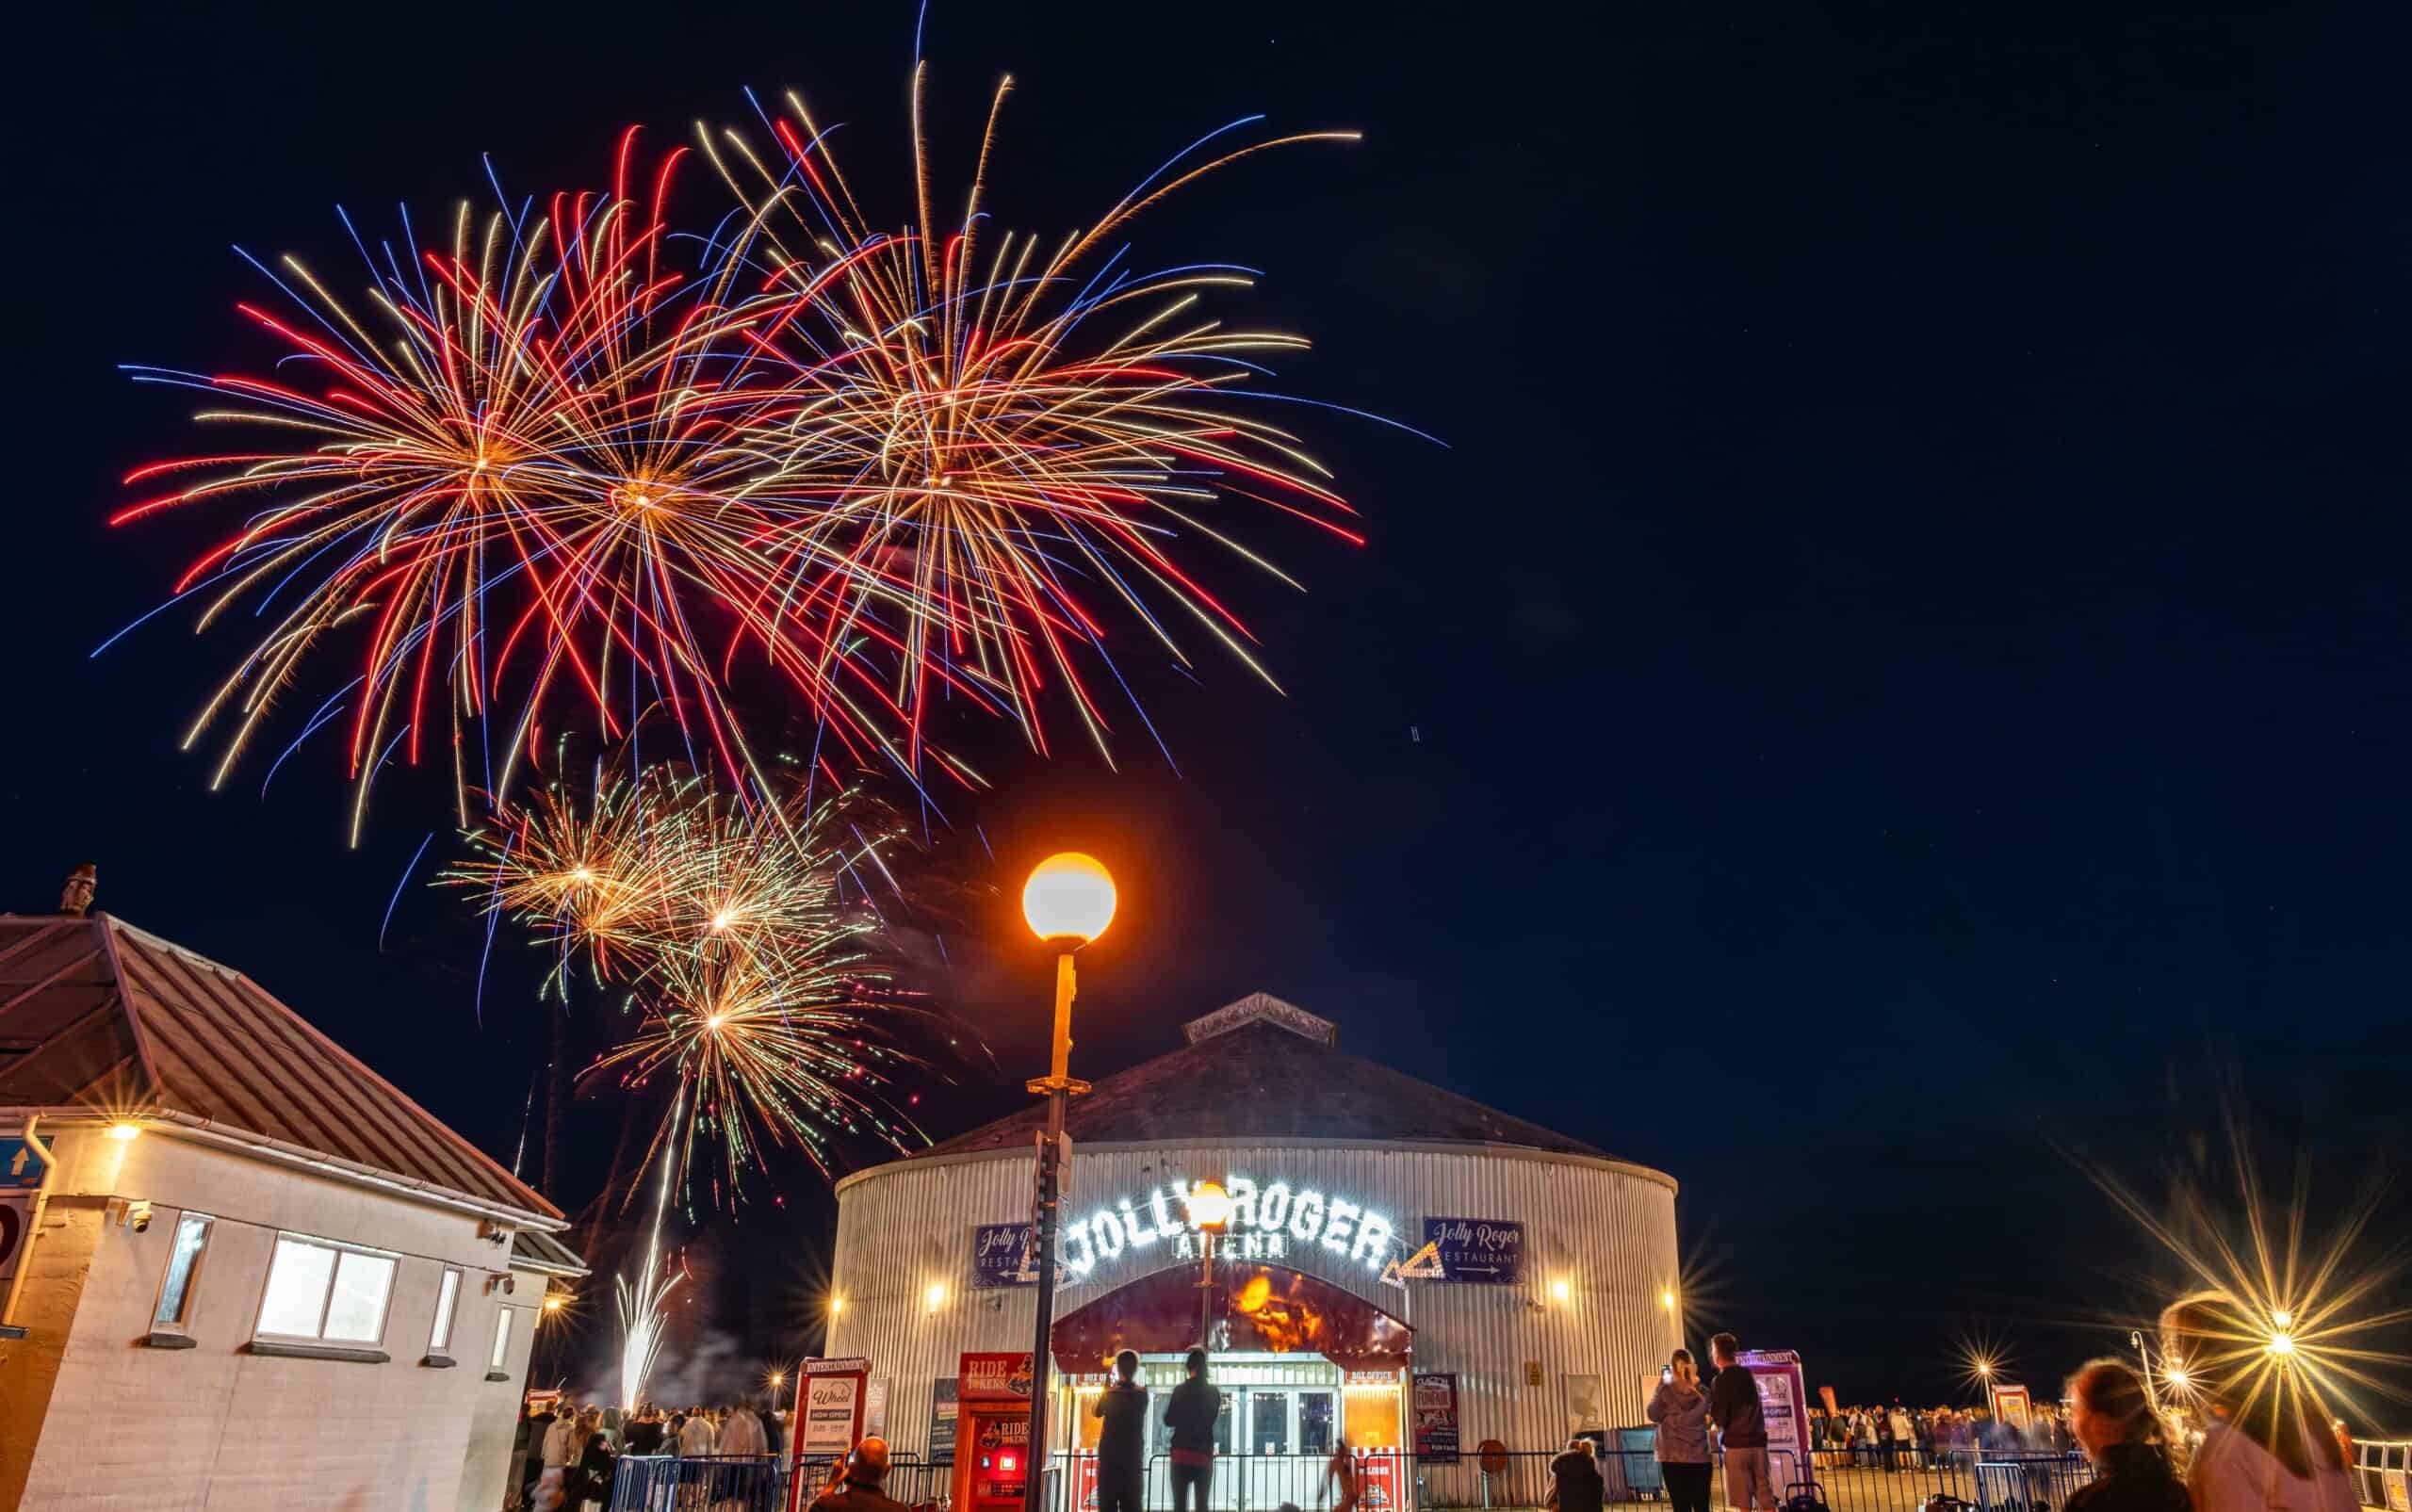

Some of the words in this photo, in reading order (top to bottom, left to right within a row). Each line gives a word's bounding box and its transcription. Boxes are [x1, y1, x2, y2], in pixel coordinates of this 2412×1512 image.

[1226, 1174, 1393, 1270] ROGER
[979, 1227, 1016, 1257] Jolly
[1432, 1221, 1473, 1248] Jolly
[1476, 1224, 1519, 1251] Roger
[1443, 1250, 1519, 1265] ESTAURANT
[806, 1359, 864, 1373] ENTERTAINMENT
[969, 1360, 1008, 1378] RIDE
[1351, 1371, 1365, 1380] BOX
[1367, 1371, 1393, 1380] OFFICE
[812, 1390, 852, 1406] Wheel
[1002, 1423, 1029, 1436] RIDE
